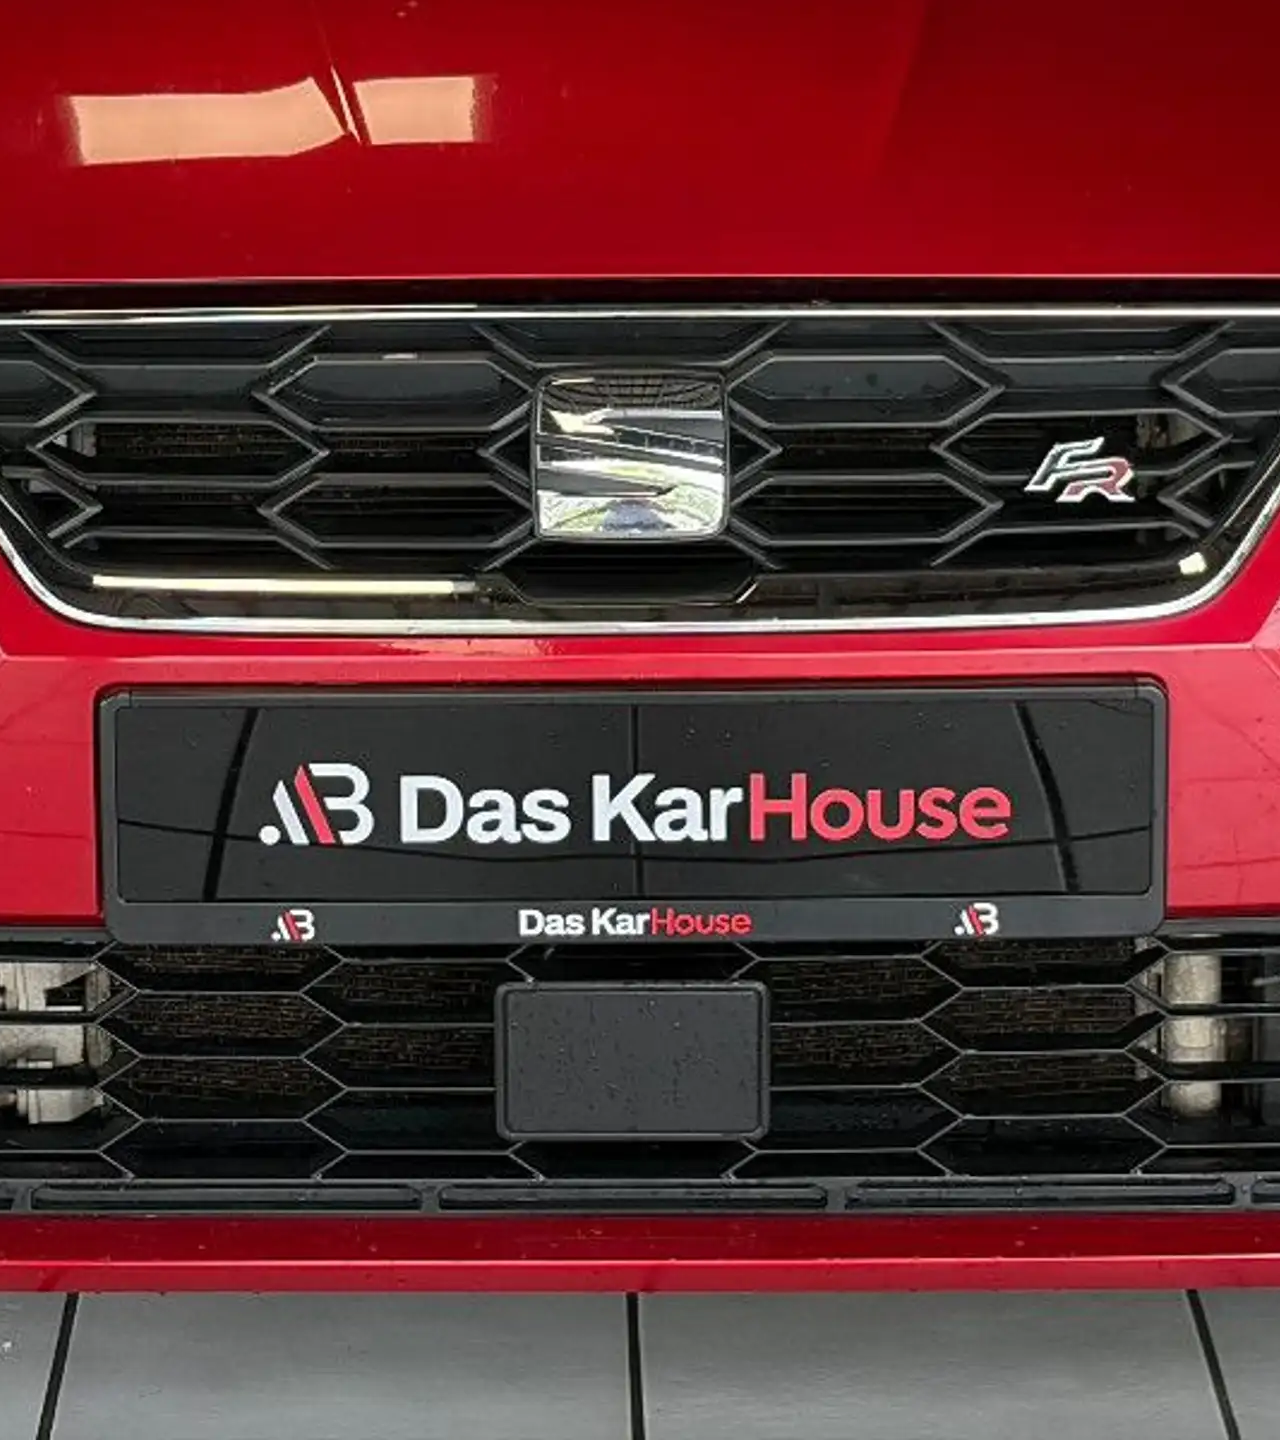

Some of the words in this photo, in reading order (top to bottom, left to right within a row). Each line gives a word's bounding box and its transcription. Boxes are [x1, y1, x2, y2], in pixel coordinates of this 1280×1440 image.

[1024, 435, 1135, 503] FR
[399, 774, 572, 845] Das
[591, 772, 1012, 843] KarHouse
[518, 908, 587, 937] Das
[590, 906, 753, 936] KarHouse
